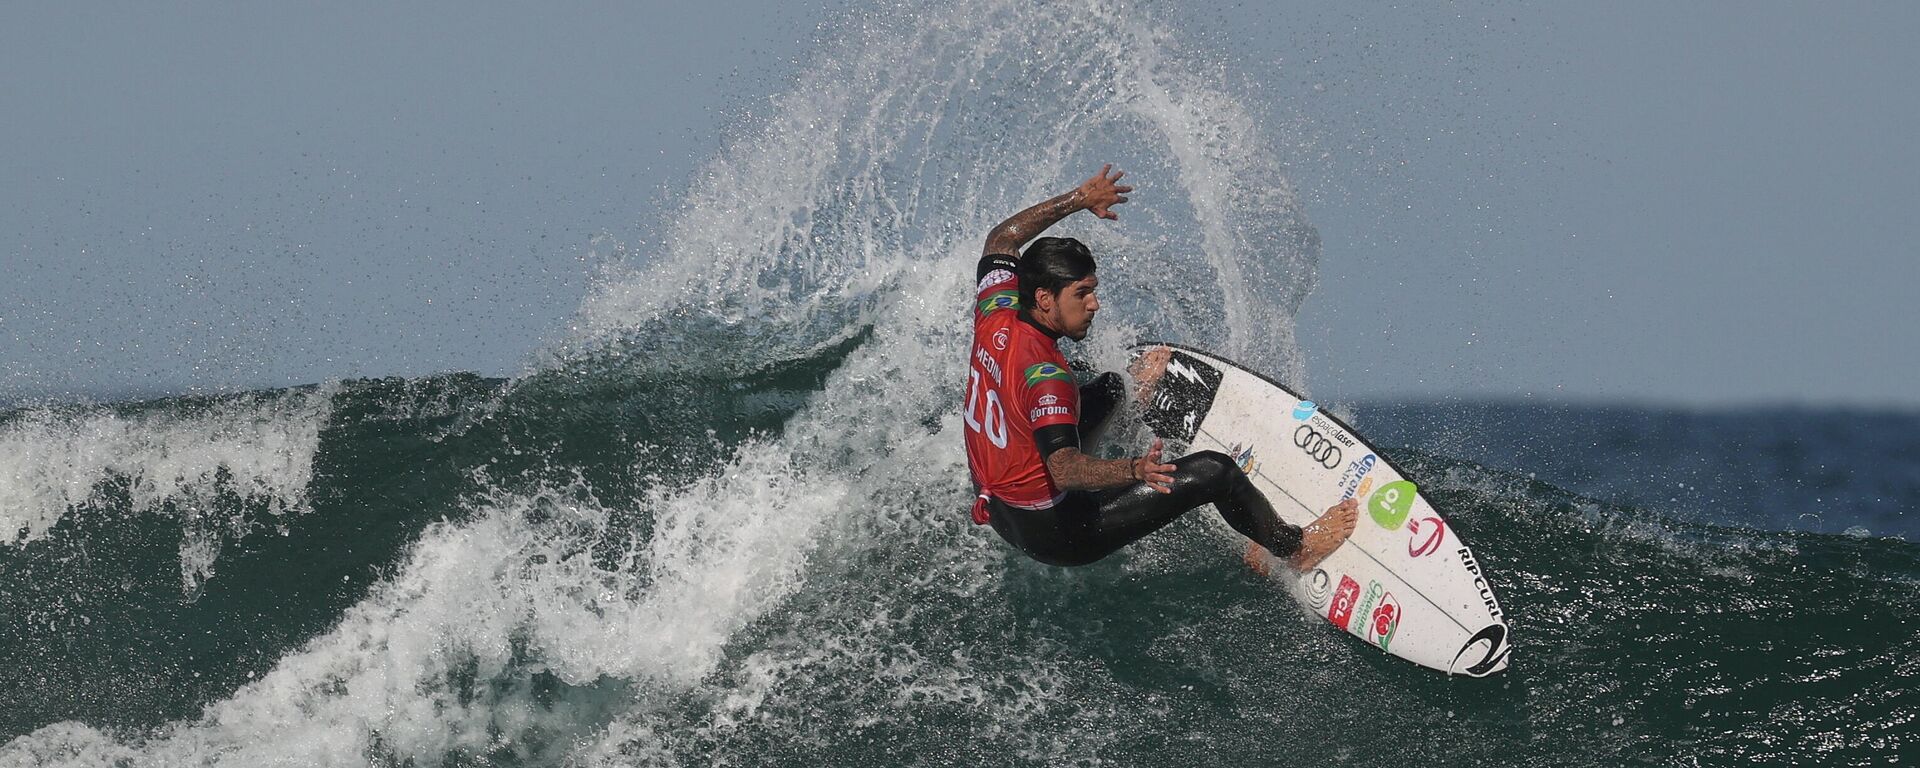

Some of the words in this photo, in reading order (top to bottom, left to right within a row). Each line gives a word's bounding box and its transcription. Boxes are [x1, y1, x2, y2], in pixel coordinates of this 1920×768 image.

[975, 343, 1002, 388] MEDINA
[964, 366, 1008, 449] 10
[1030, 406, 1068, 422] Corona
[1341, 454, 1376, 502] Coron
[1334, 587, 1354, 619] TCL
[1457, 547, 1479, 576] RIP
[1474, 578, 1501, 621] CURL
